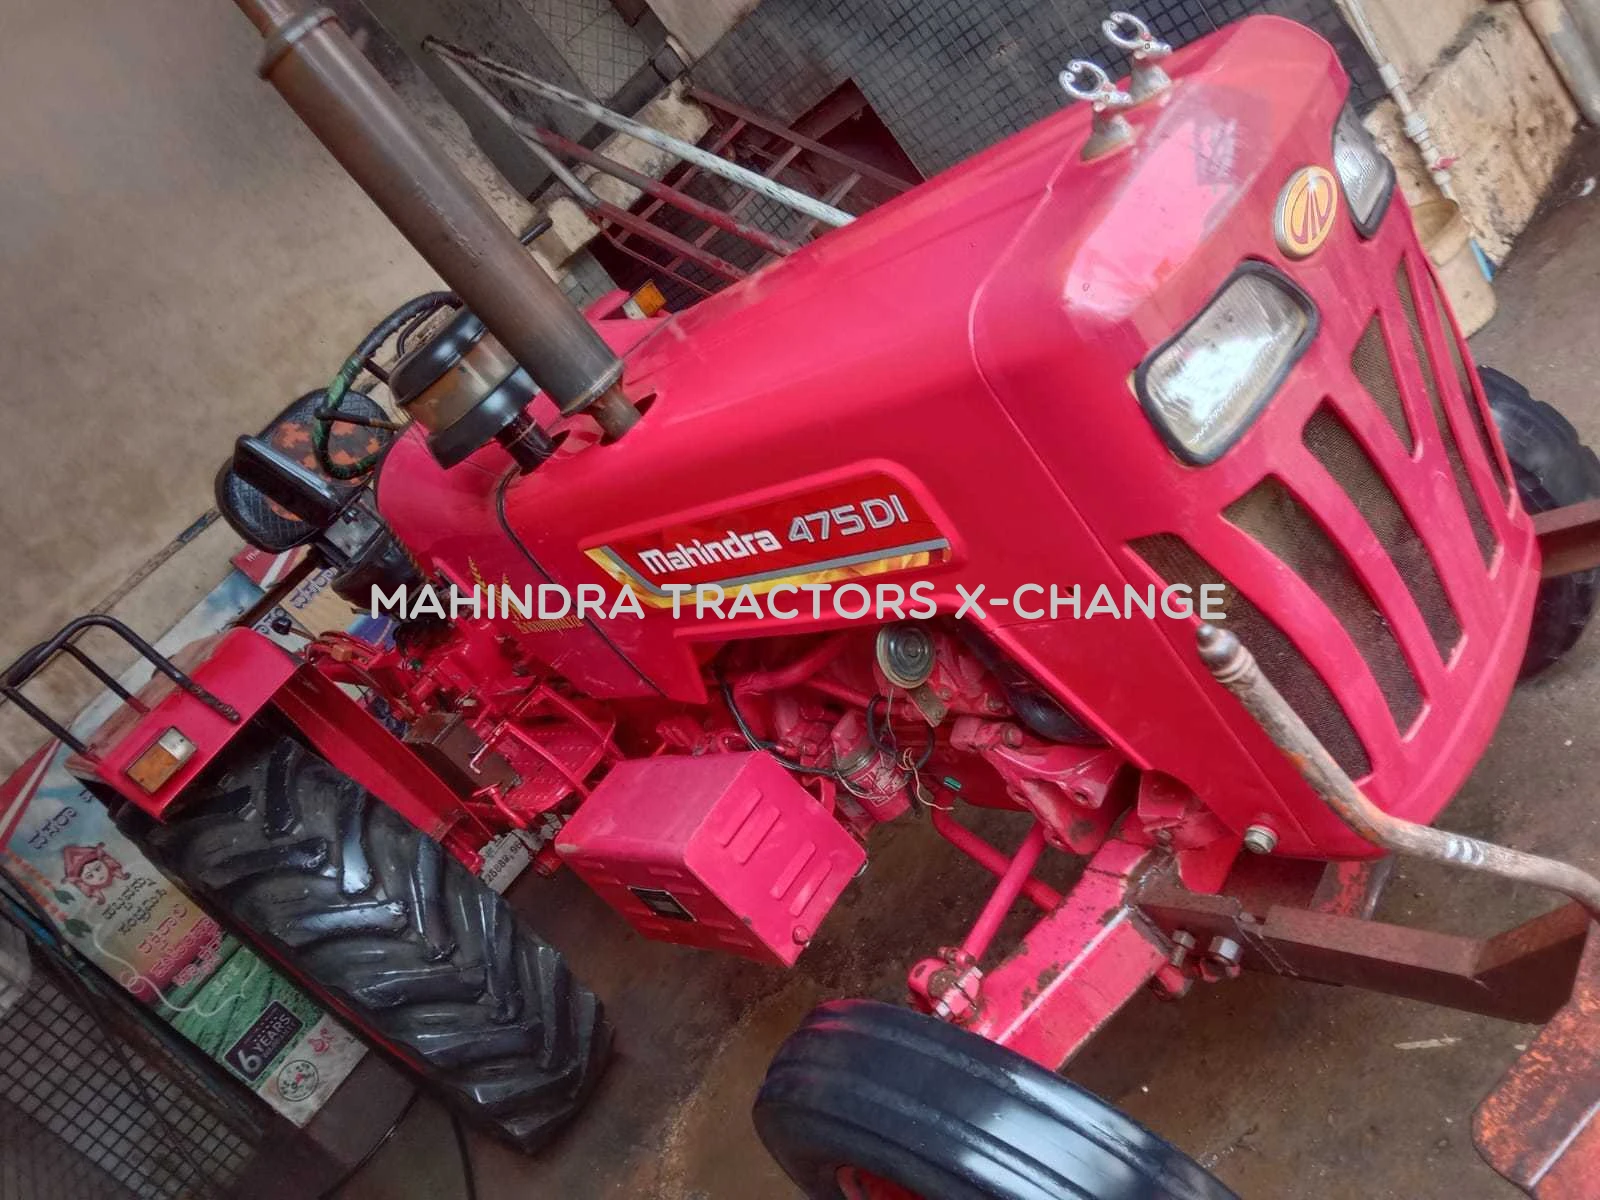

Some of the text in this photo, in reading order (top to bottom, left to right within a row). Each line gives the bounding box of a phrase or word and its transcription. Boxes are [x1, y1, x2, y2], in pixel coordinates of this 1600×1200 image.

[638, 494, 909, 575] Mahindra 475DI
[27, 805, 77, 850] ದಸರಾ
[237, 1049, 262, 1074] 6
[254, 1014, 291, 1052] YEARS
